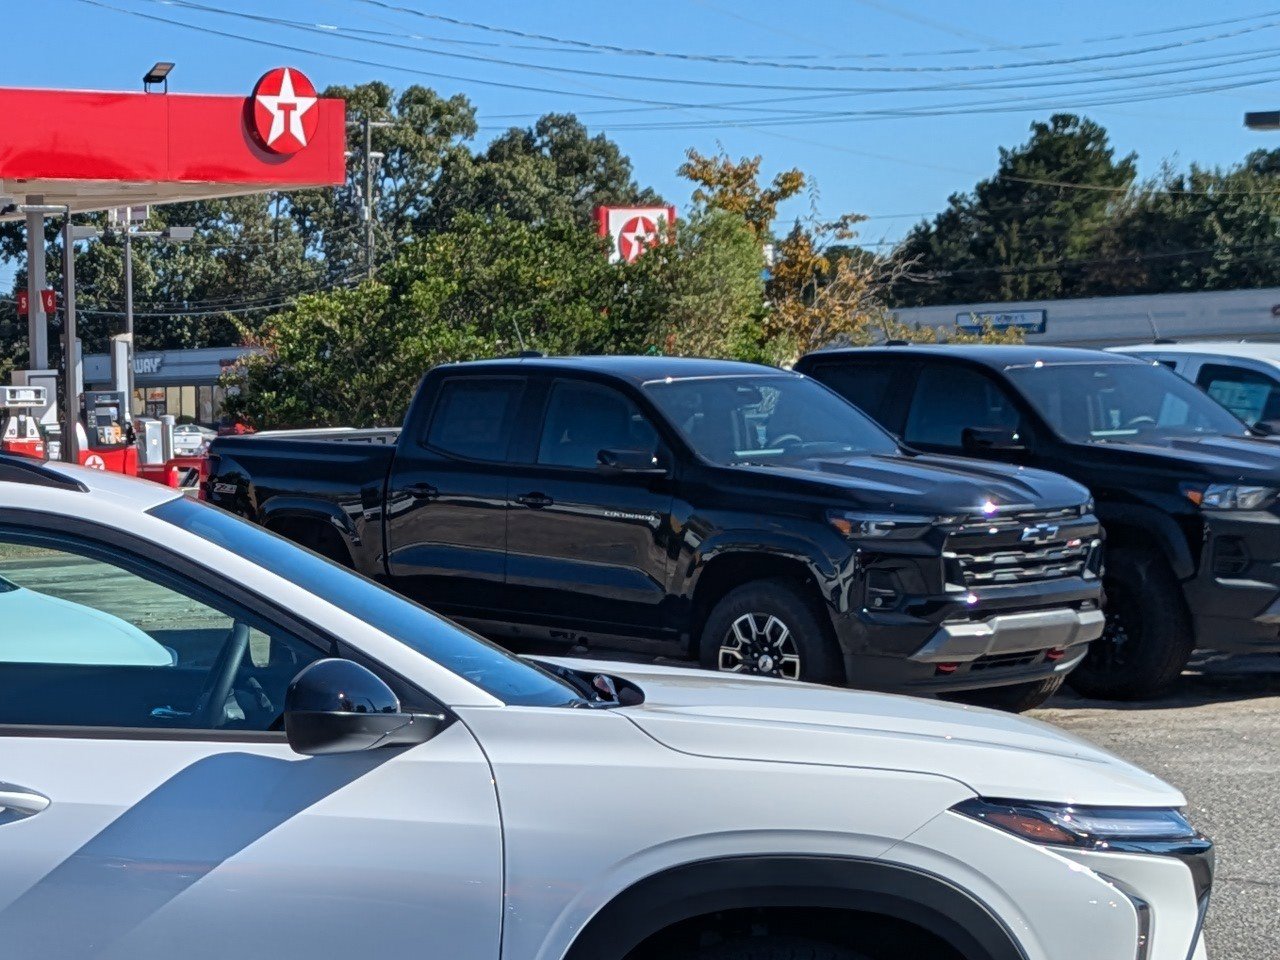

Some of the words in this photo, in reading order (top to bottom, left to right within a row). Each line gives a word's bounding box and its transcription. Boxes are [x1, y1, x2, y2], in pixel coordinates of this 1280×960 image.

[21, 297, 26, 308] 5
[47, 295, 52, 307] 6
[8, 428, 16, 436] 10
[29, 428, 35, 436] 9
